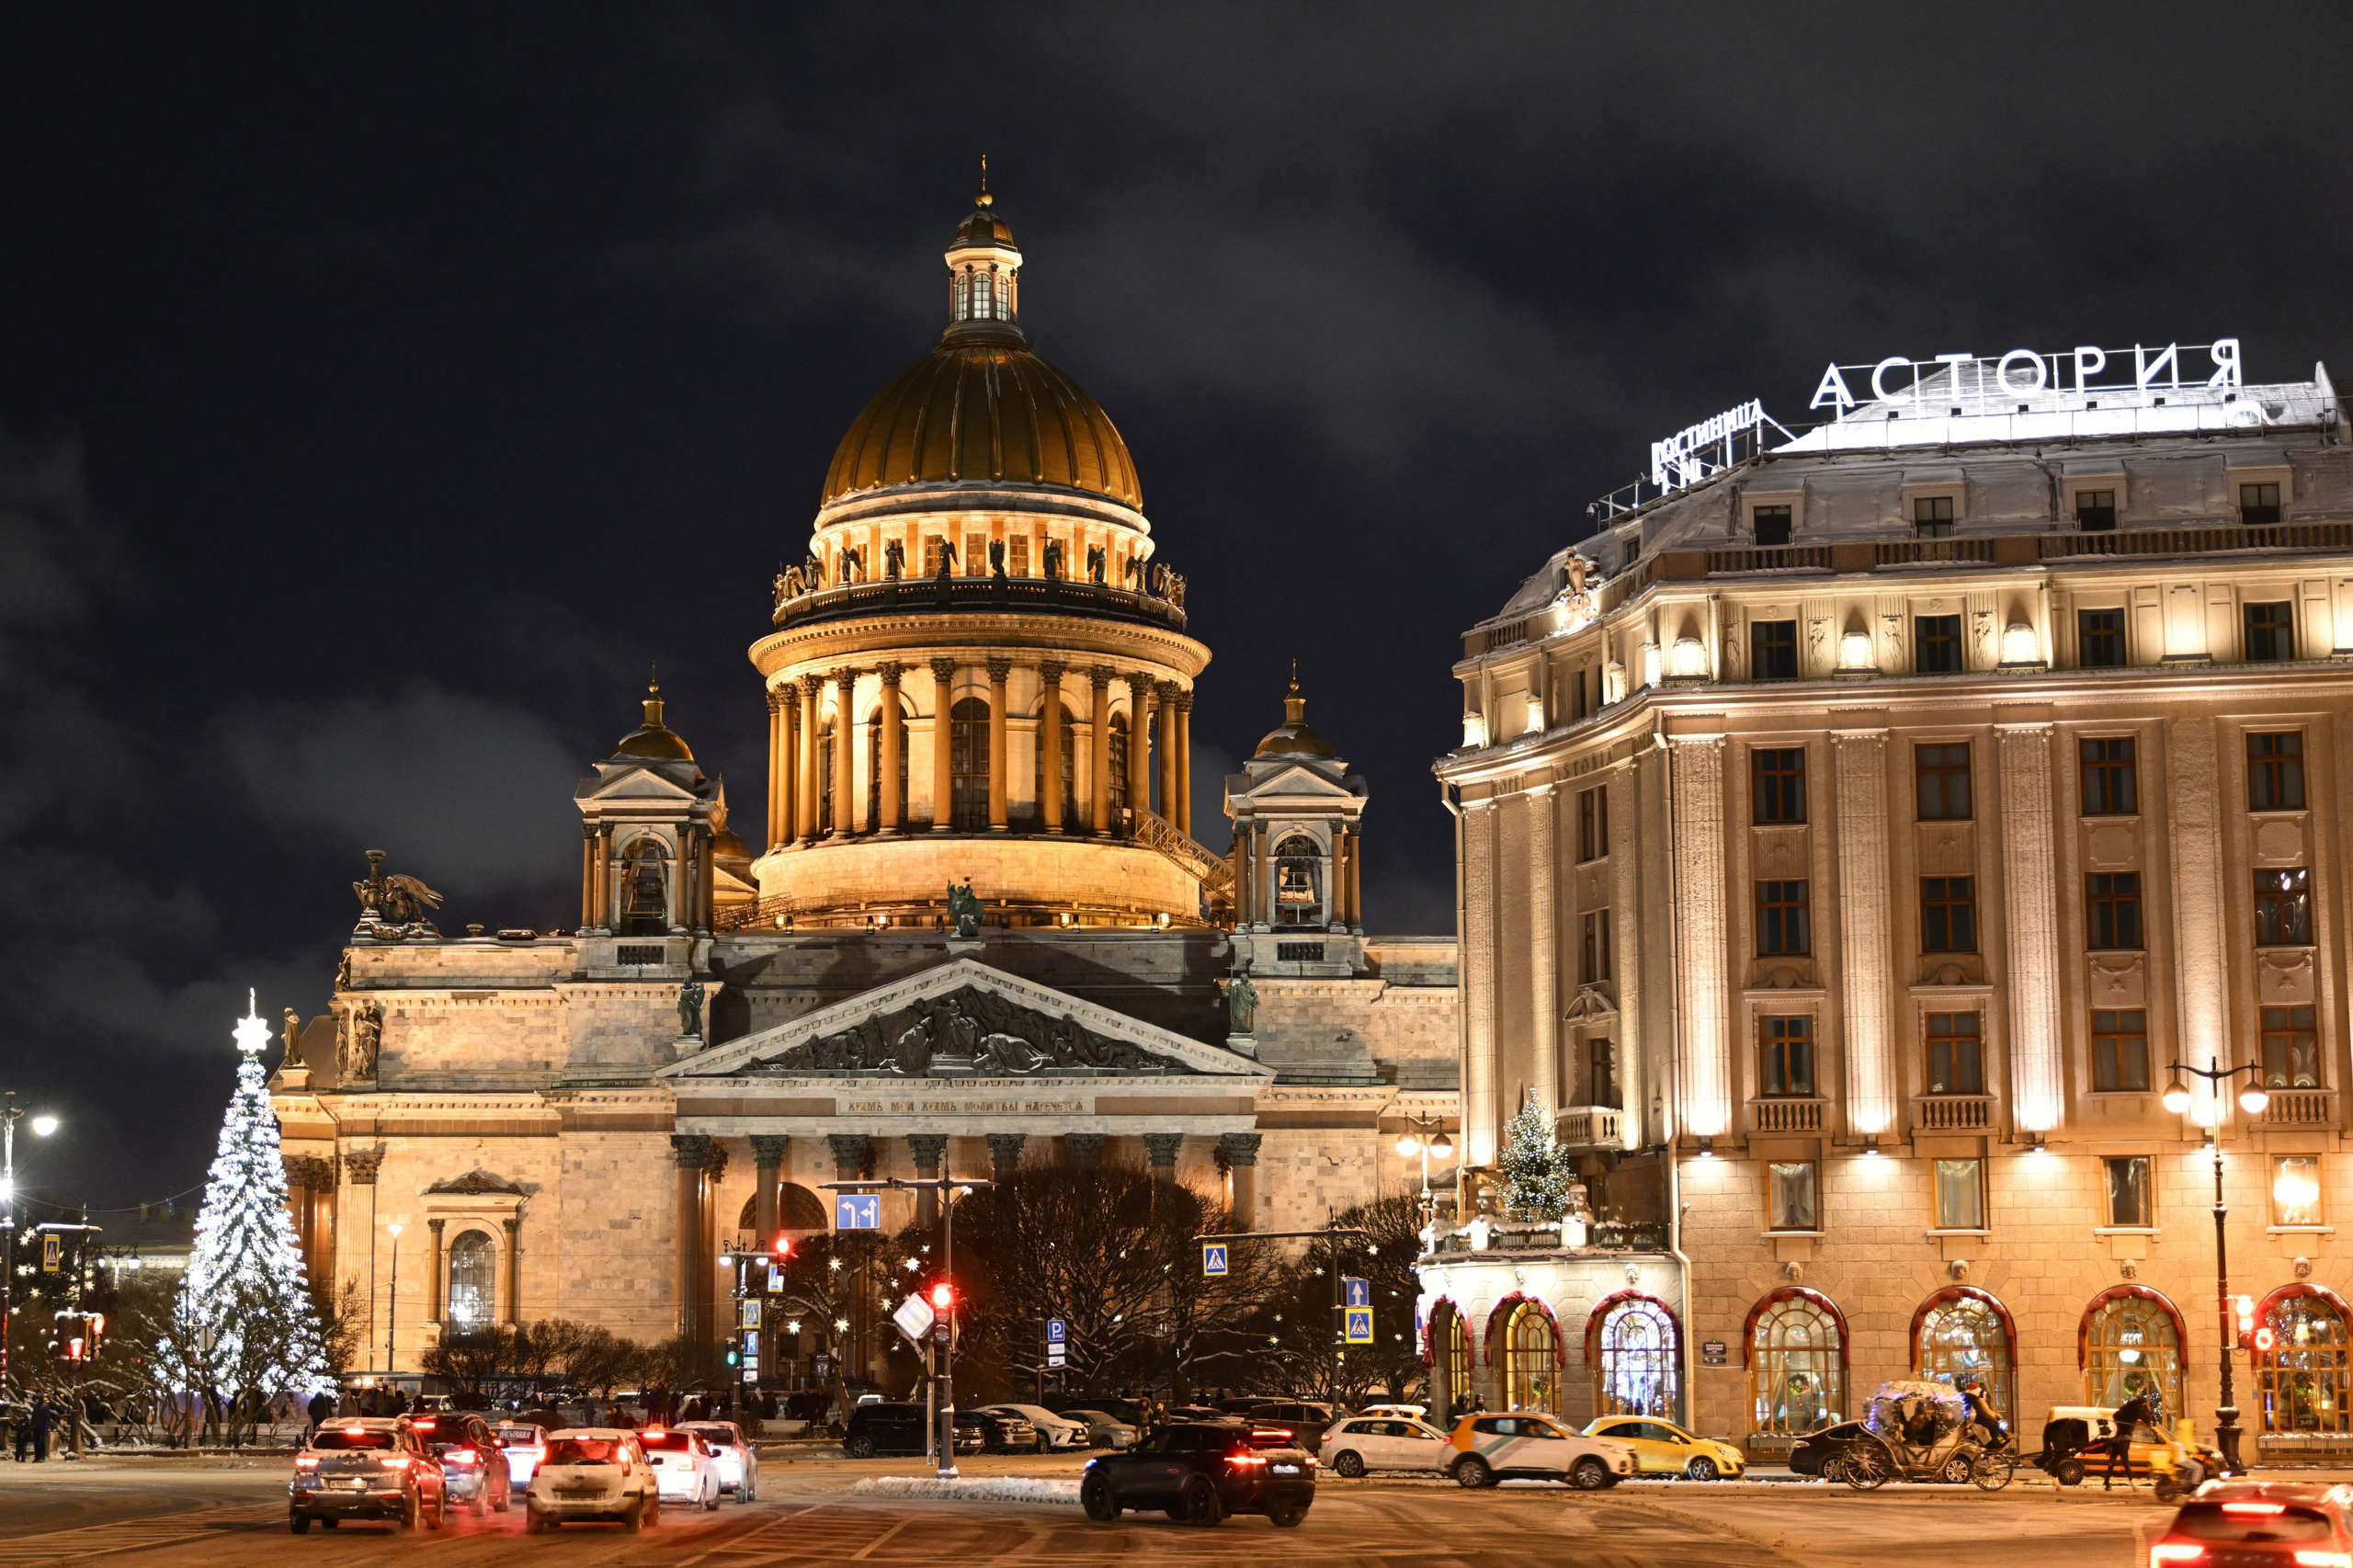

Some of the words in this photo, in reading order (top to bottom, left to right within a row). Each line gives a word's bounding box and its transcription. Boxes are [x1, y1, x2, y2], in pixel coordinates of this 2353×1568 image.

[1810, 338, 2242, 410] АСТОРИЯ
[1651, 397, 1765, 476] ГОСТИНИЦА
[1051, 1322, 1062, 1339] P
